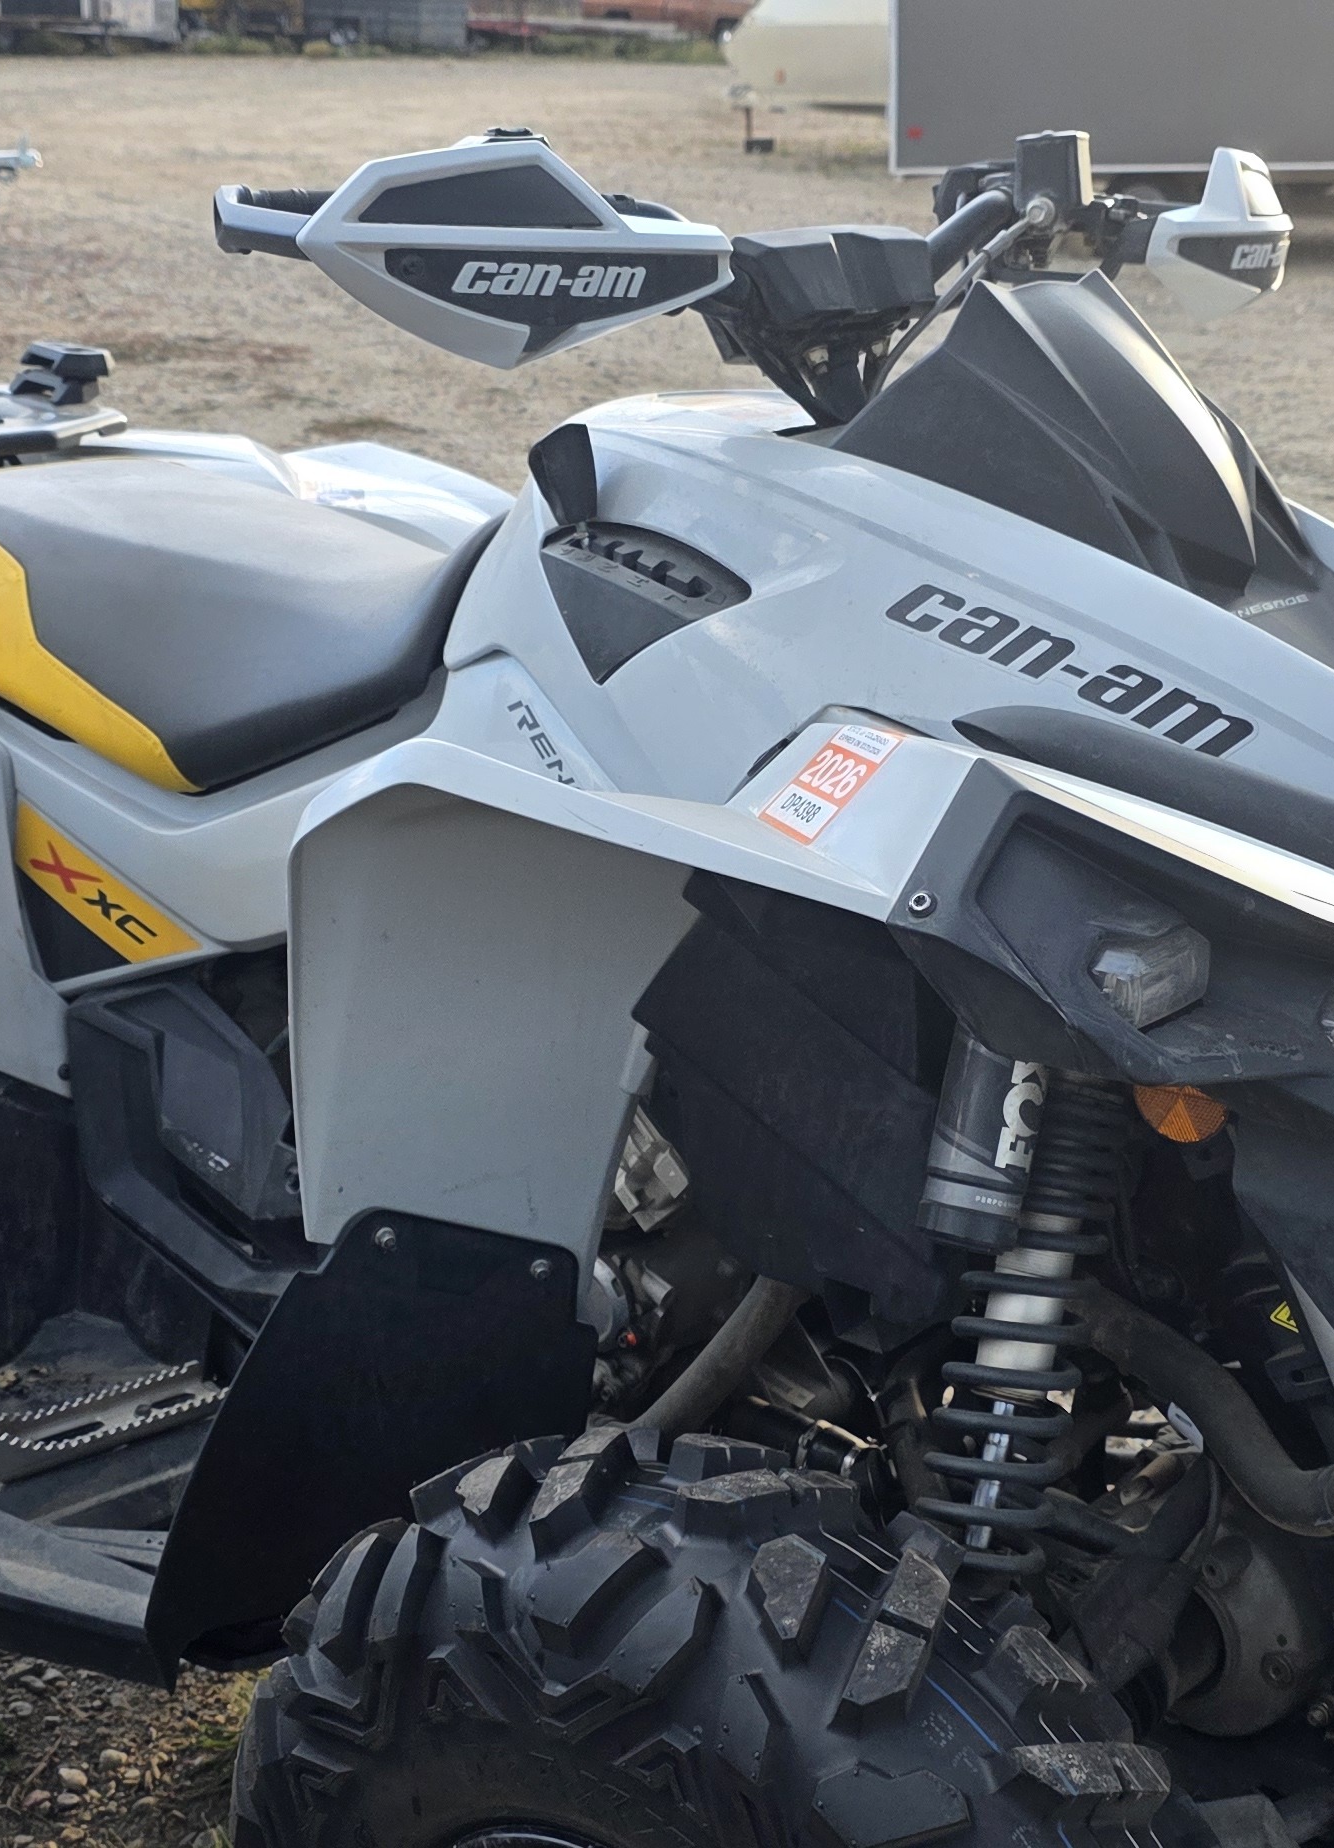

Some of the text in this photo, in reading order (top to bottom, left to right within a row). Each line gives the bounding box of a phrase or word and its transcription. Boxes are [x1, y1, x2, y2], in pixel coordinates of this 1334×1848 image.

[451, 261, 646, 298] can-am
[1232, 593, 1309, 618] NEGADE
[885, 583, 1255, 757] can-am
[507, 700, 581, 789] REN
[798, 749, 867, 800] 2026
[780, 792, 822, 824] DP4398
